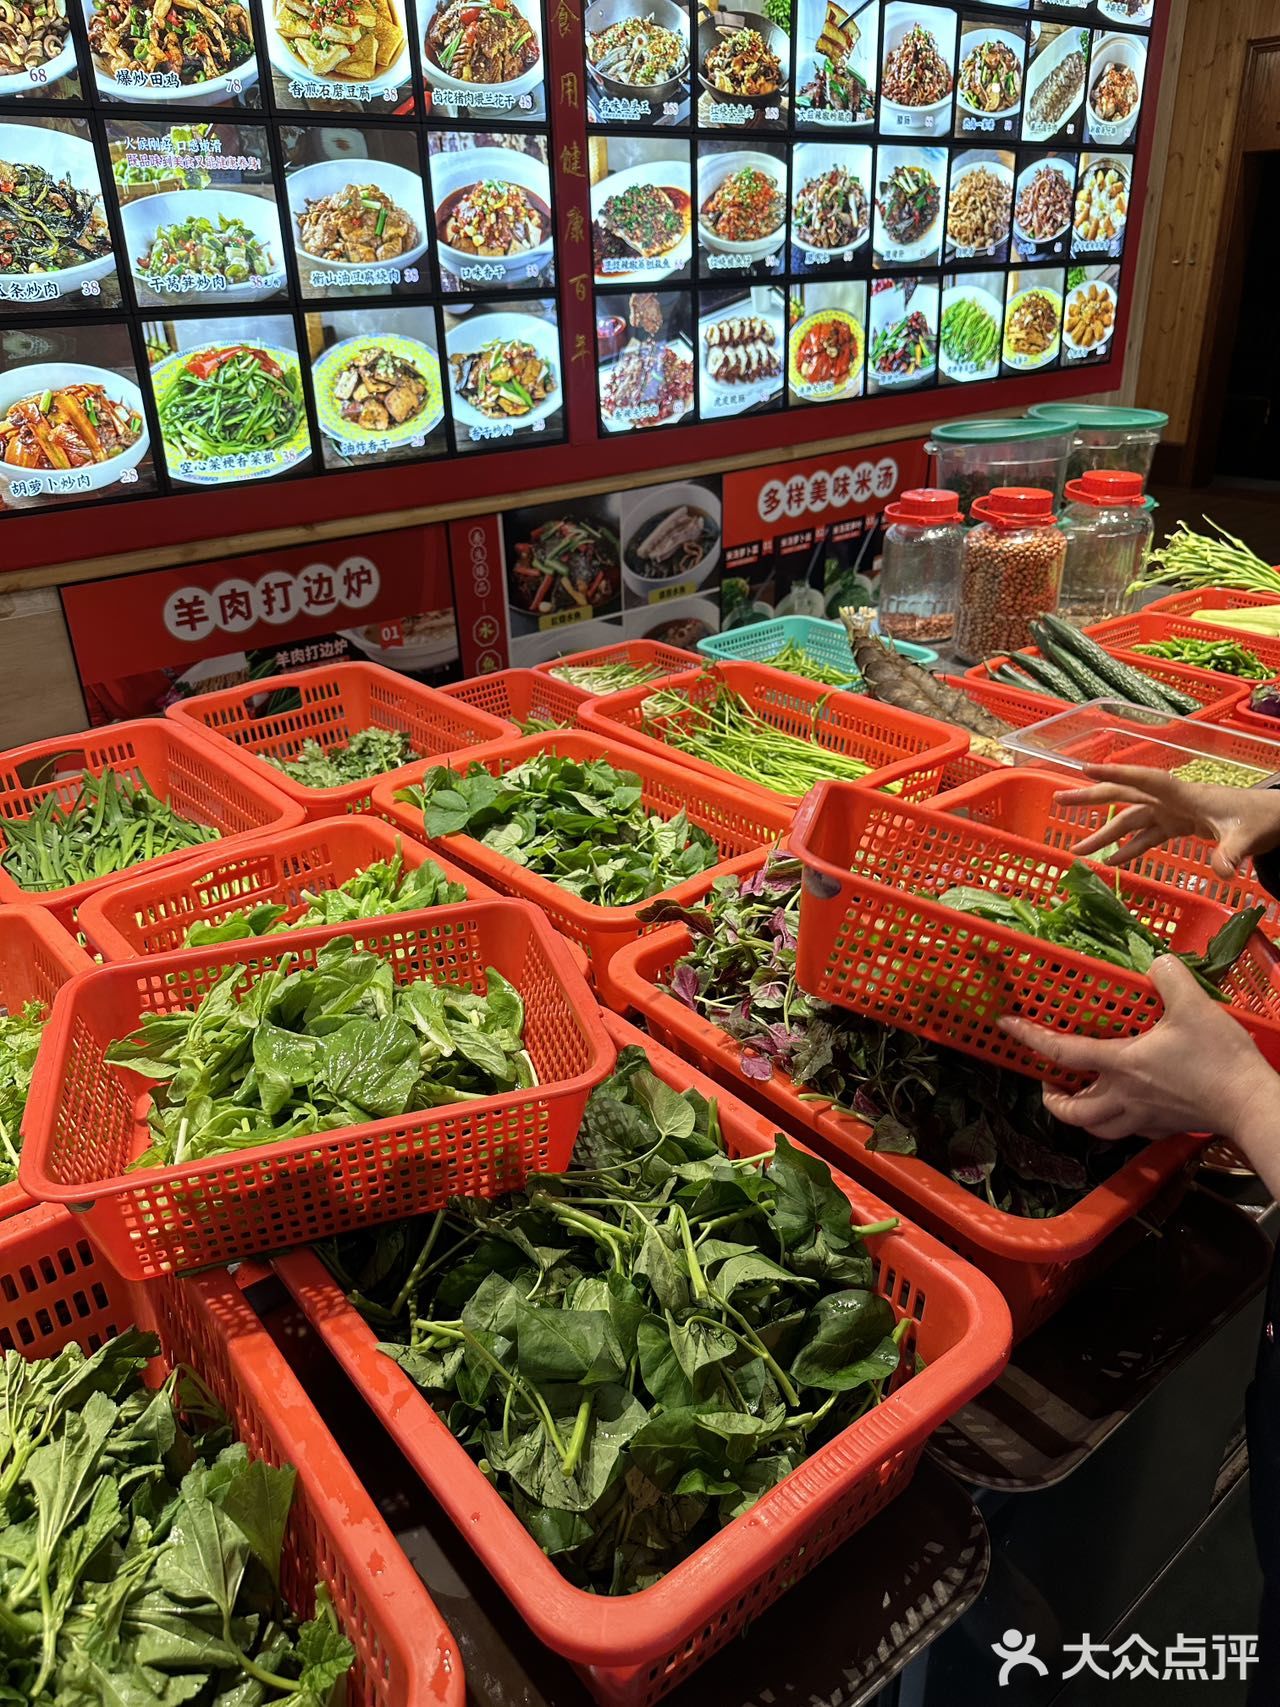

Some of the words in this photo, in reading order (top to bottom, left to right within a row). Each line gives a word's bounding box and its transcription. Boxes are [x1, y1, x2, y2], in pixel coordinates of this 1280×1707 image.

[29, 68, 47, 83] 68
[115, 70, 181, 88] 爆炒田鸡
[225, 78, 242, 93] 78
[290, 81, 371, 101] 香煎石磨豆腐
[383, 87, 398, 102] 38
[81, 280, 100, 296] 38
[150, 276, 226, 293] 干莴笋炒肉
[11, 474, 91, 497] 胡萝卜炒肉
[121, 468, 138, 483] 28
[764, 465, 893, 516] 多样美味米汤
[174, 565, 374, 632] 羊肉打边炉
[381, 625, 400, 642] 01
[275, 638, 349, 667] 羊肉打边炉
